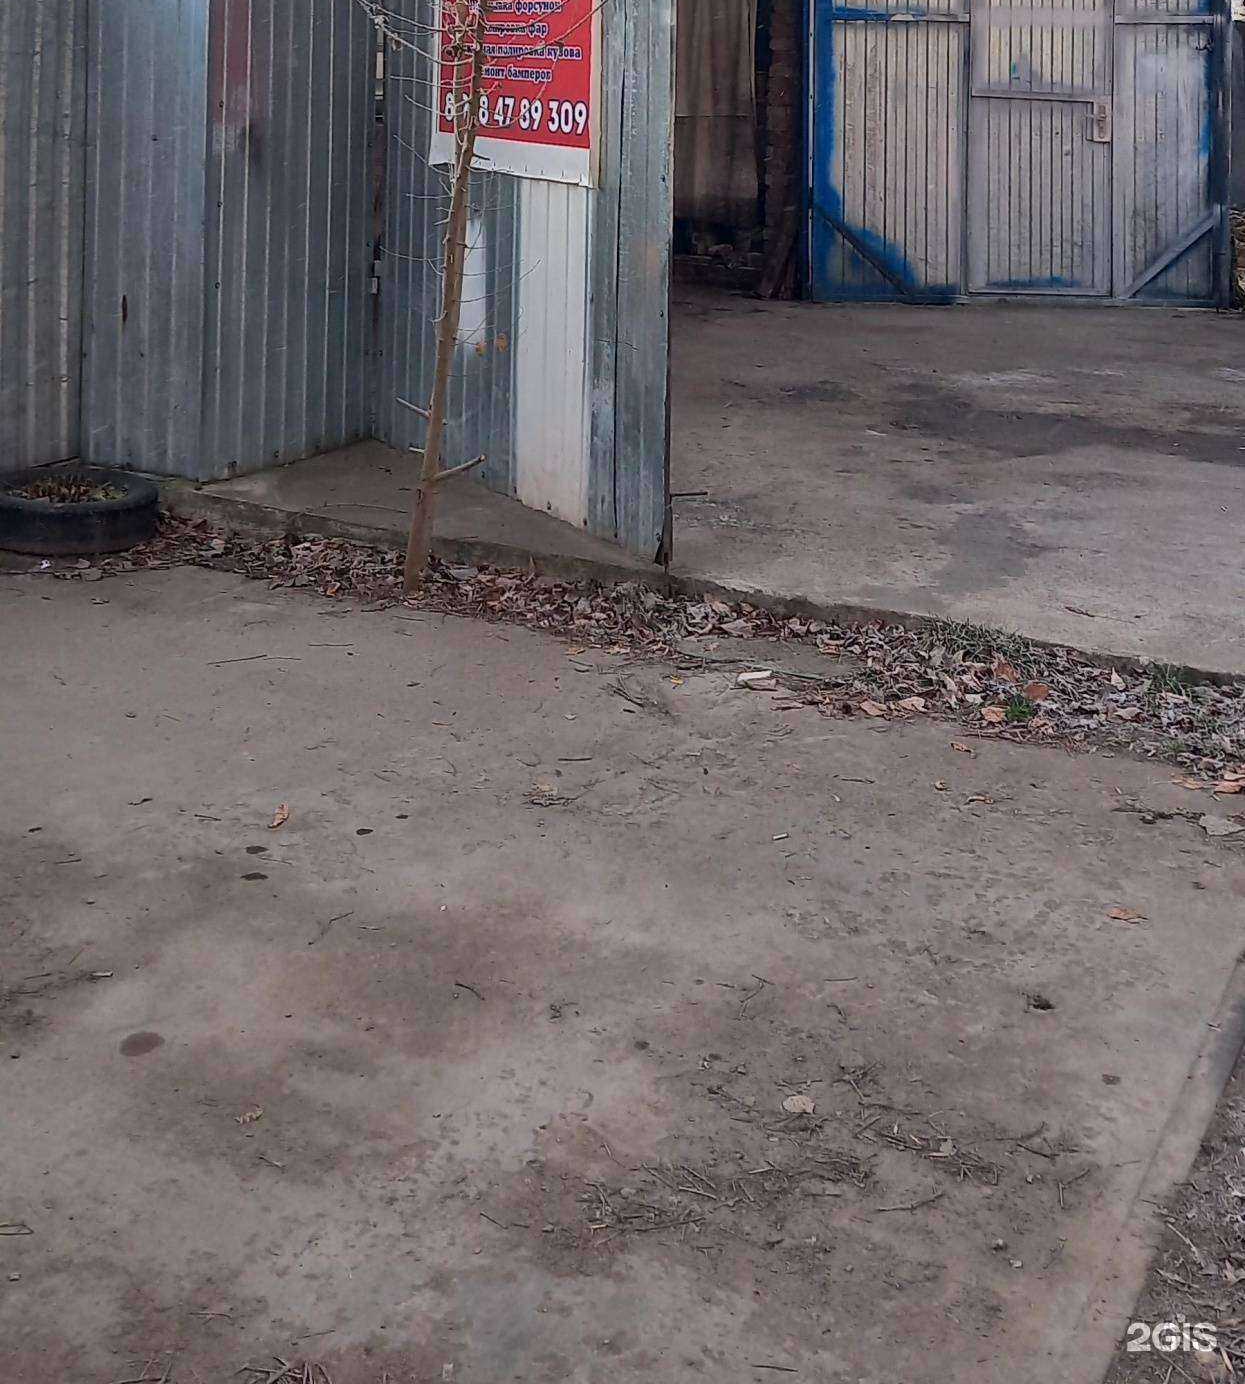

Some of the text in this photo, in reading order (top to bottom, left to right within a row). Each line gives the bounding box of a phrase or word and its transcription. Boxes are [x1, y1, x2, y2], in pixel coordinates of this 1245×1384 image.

[494, 96, 515, 126] 47
[519, 98, 542, 130] 89
[548, 100, 588, 134] 309
